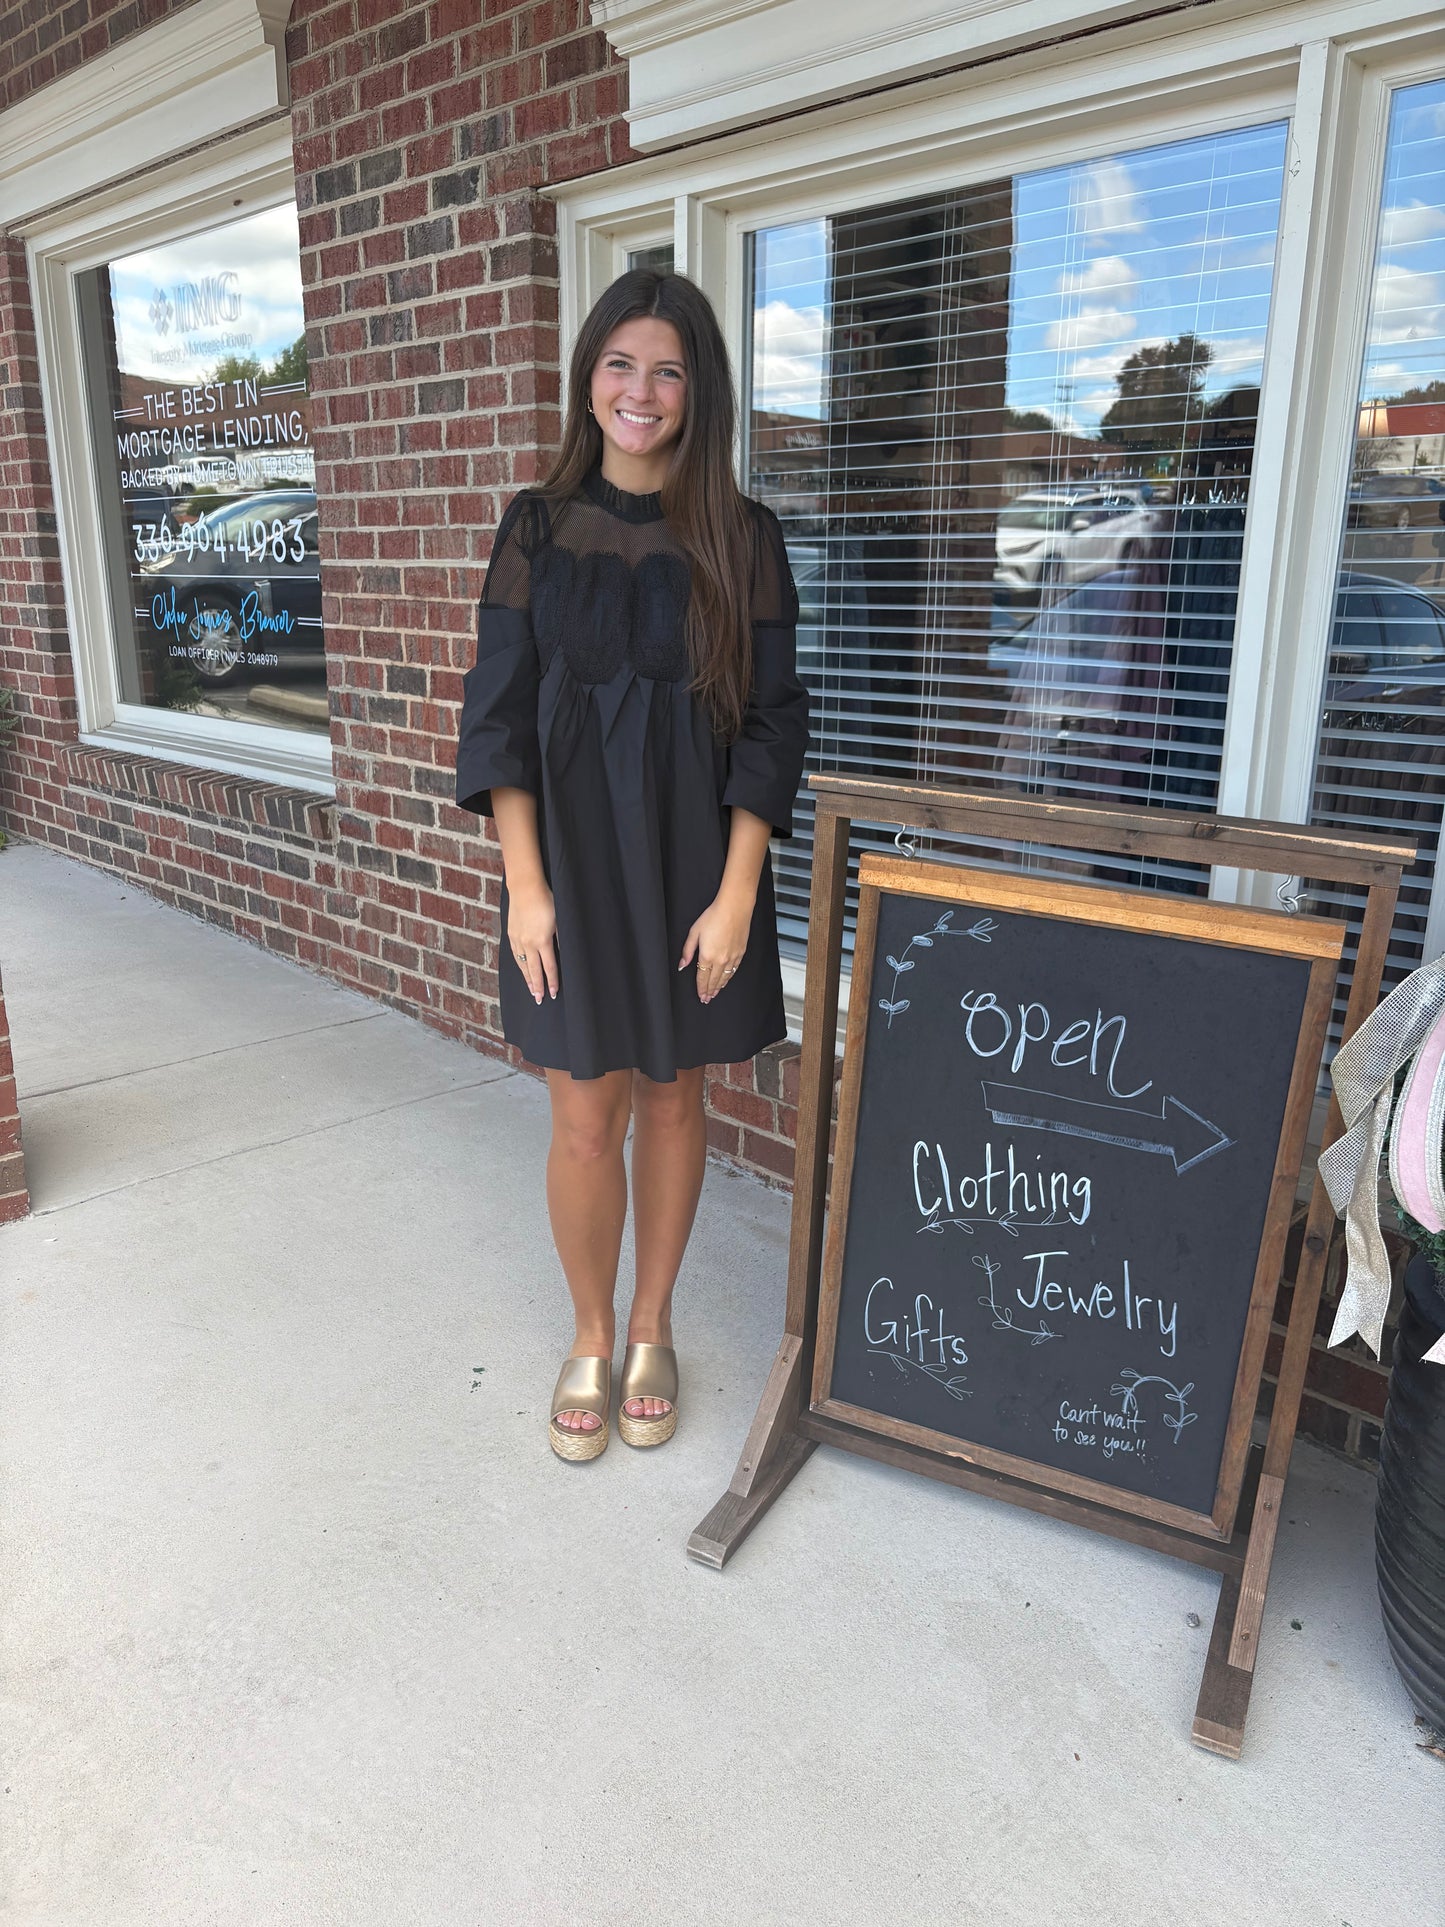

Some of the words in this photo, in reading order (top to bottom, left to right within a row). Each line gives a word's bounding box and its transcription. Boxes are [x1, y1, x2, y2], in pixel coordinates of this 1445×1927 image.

[143, 391, 176, 421] THE
[182, 383, 225, 416] BEST
[233, 378, 258, 409] IN
[117, 423, 206, 460] MORTGAGE
[212, 410, 309, 450] LENDING,
[121, 468, 162, 489] BACKED
[166, 467, 182, 485] BY
[185, 460, 258, 484] HOMETOWN
[239, 590, 294, 643] Brewer
[169, 645, 187, 658] LOAN
[188, 648, 220, 661] OFFICER
[225, 651, 246, 664] NMLS
[247, 652, 278, 667] 2048979
[960, 988, 1153, 1098] Open
[911, 1139, 1092, 1226] Clothing
[864, 1276, 969, 1366] Gifts
[1015, 1250, 1179, 1357] Jewelry
[1052, 1420, 1069, 1443] to
[1074, 1430, 1096, 1446] see
[1103, 1436, 1146, 1459] you!!
[1103, 1409, 1146, 1434] wait
